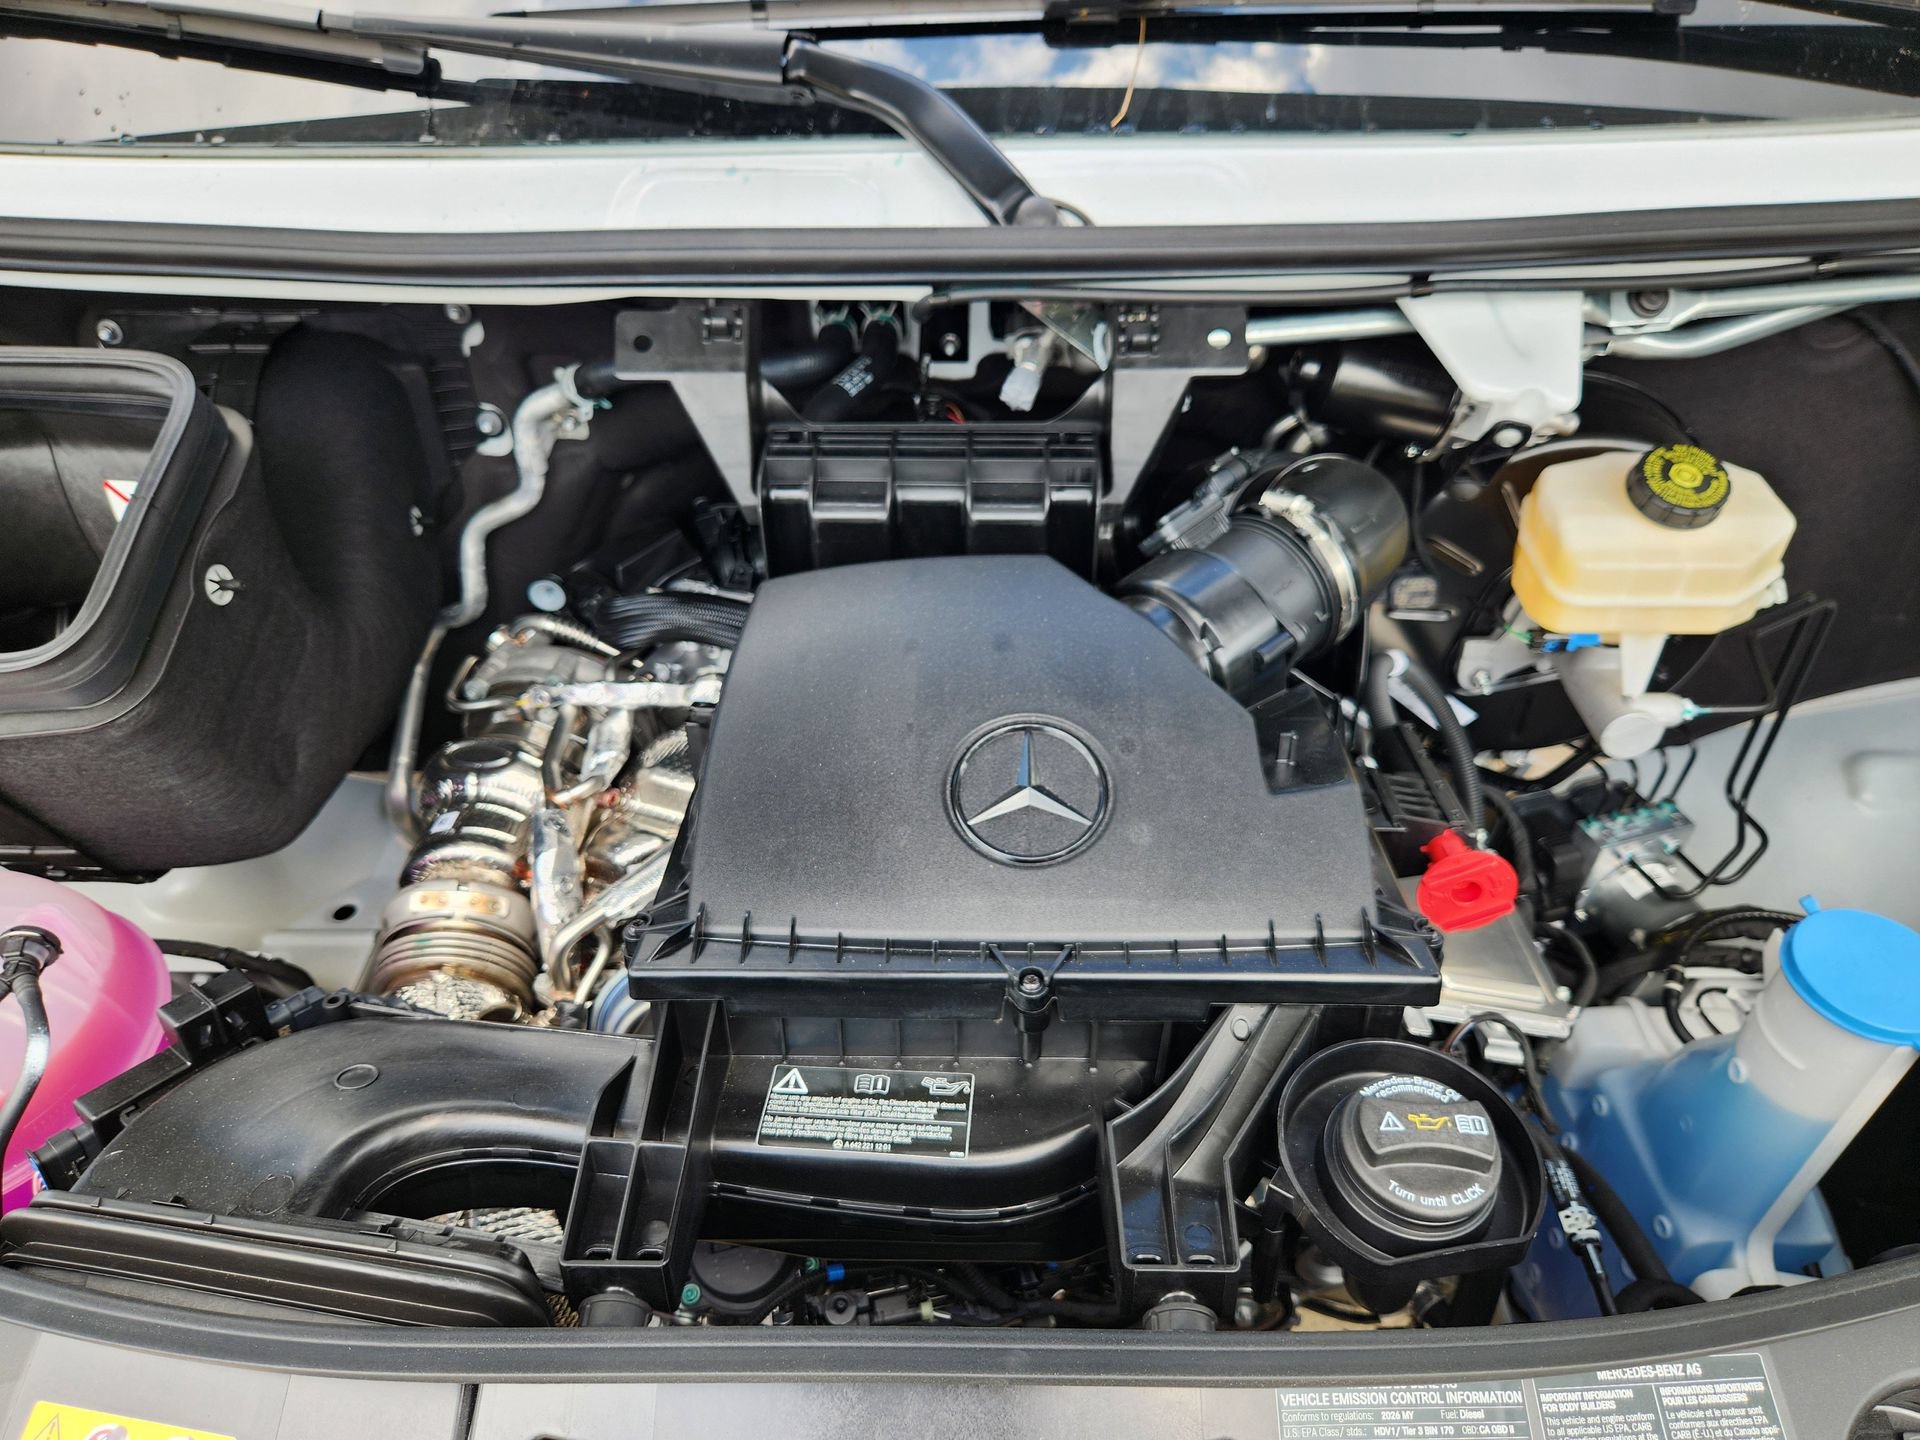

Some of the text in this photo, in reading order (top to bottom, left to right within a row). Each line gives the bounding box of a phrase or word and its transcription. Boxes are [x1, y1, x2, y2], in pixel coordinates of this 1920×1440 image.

[1359, 1075, 1444, 1097] Mercedes-Benz
[1375, 1084, 1450, 1104] recommended
[843, 1141, 849, 1149] A
[1388, 1180, 1485, 1206] Turn until CLICK
[1596, 1363, 1702, 1381] MERCEDES-BENZ AG
[1540, 1389, 1633, 1402] IMPORTANT INFORMATION
[1660, 1382, 1764, 1396] INFORMATIONS IMPORTANTES
[1280, 1390, 1522, 1406] VEHICLE EMISSION CONTROL INFORMATION
[1662, 1393, 1748, 1406] POUR LES CARROSSIERS
[1542, 1400, 1616, 1412] FOR BODY BUILDERS
[1666, 1410, 1675, 1419] Le
[1714, 1409, 1721, 1417] le
[1722, 1408, 1746, 1416] moteur
[1748, 1406, 1763, 1414] sont
[1282, 1411, 1374, 1422] Conforms to regulations:
[1381, 1409, 1485, 1420] 2026 MY Fuel: Diesel
[1545, 1413, 1655, 1426] This vehicle and engine conform
[1669, 1420, 1705, 1429] conformes
[1720, 1417, 1753, 1426] directives
[1753, 1416, 1768, 1424] EPA
[1284, 1428, 1300, 1437] U.S.
[1302, 1428, 1317, 1437] EPA
[1402, 1426, 1416, 1435] Tier
[1418, 1426, 1423, 1435] 3
[1424, 1426, 1438, 1435] BIN
[1440, 1426, 1454, 1435] 170
[1480, 1425, 1490, 1434] CA
[1491, 1425, 1508, 1434] OBD
[1547, 1422, 1652, 1437] to all applicable US EPA, CARB
[1671, 1430, 1691, 1440] CARB
[1715, 1429, 1723, 1437] et
[1724, 1428, 1733, 1436] du
[1734, 1427, 1760, 1436] Canada
